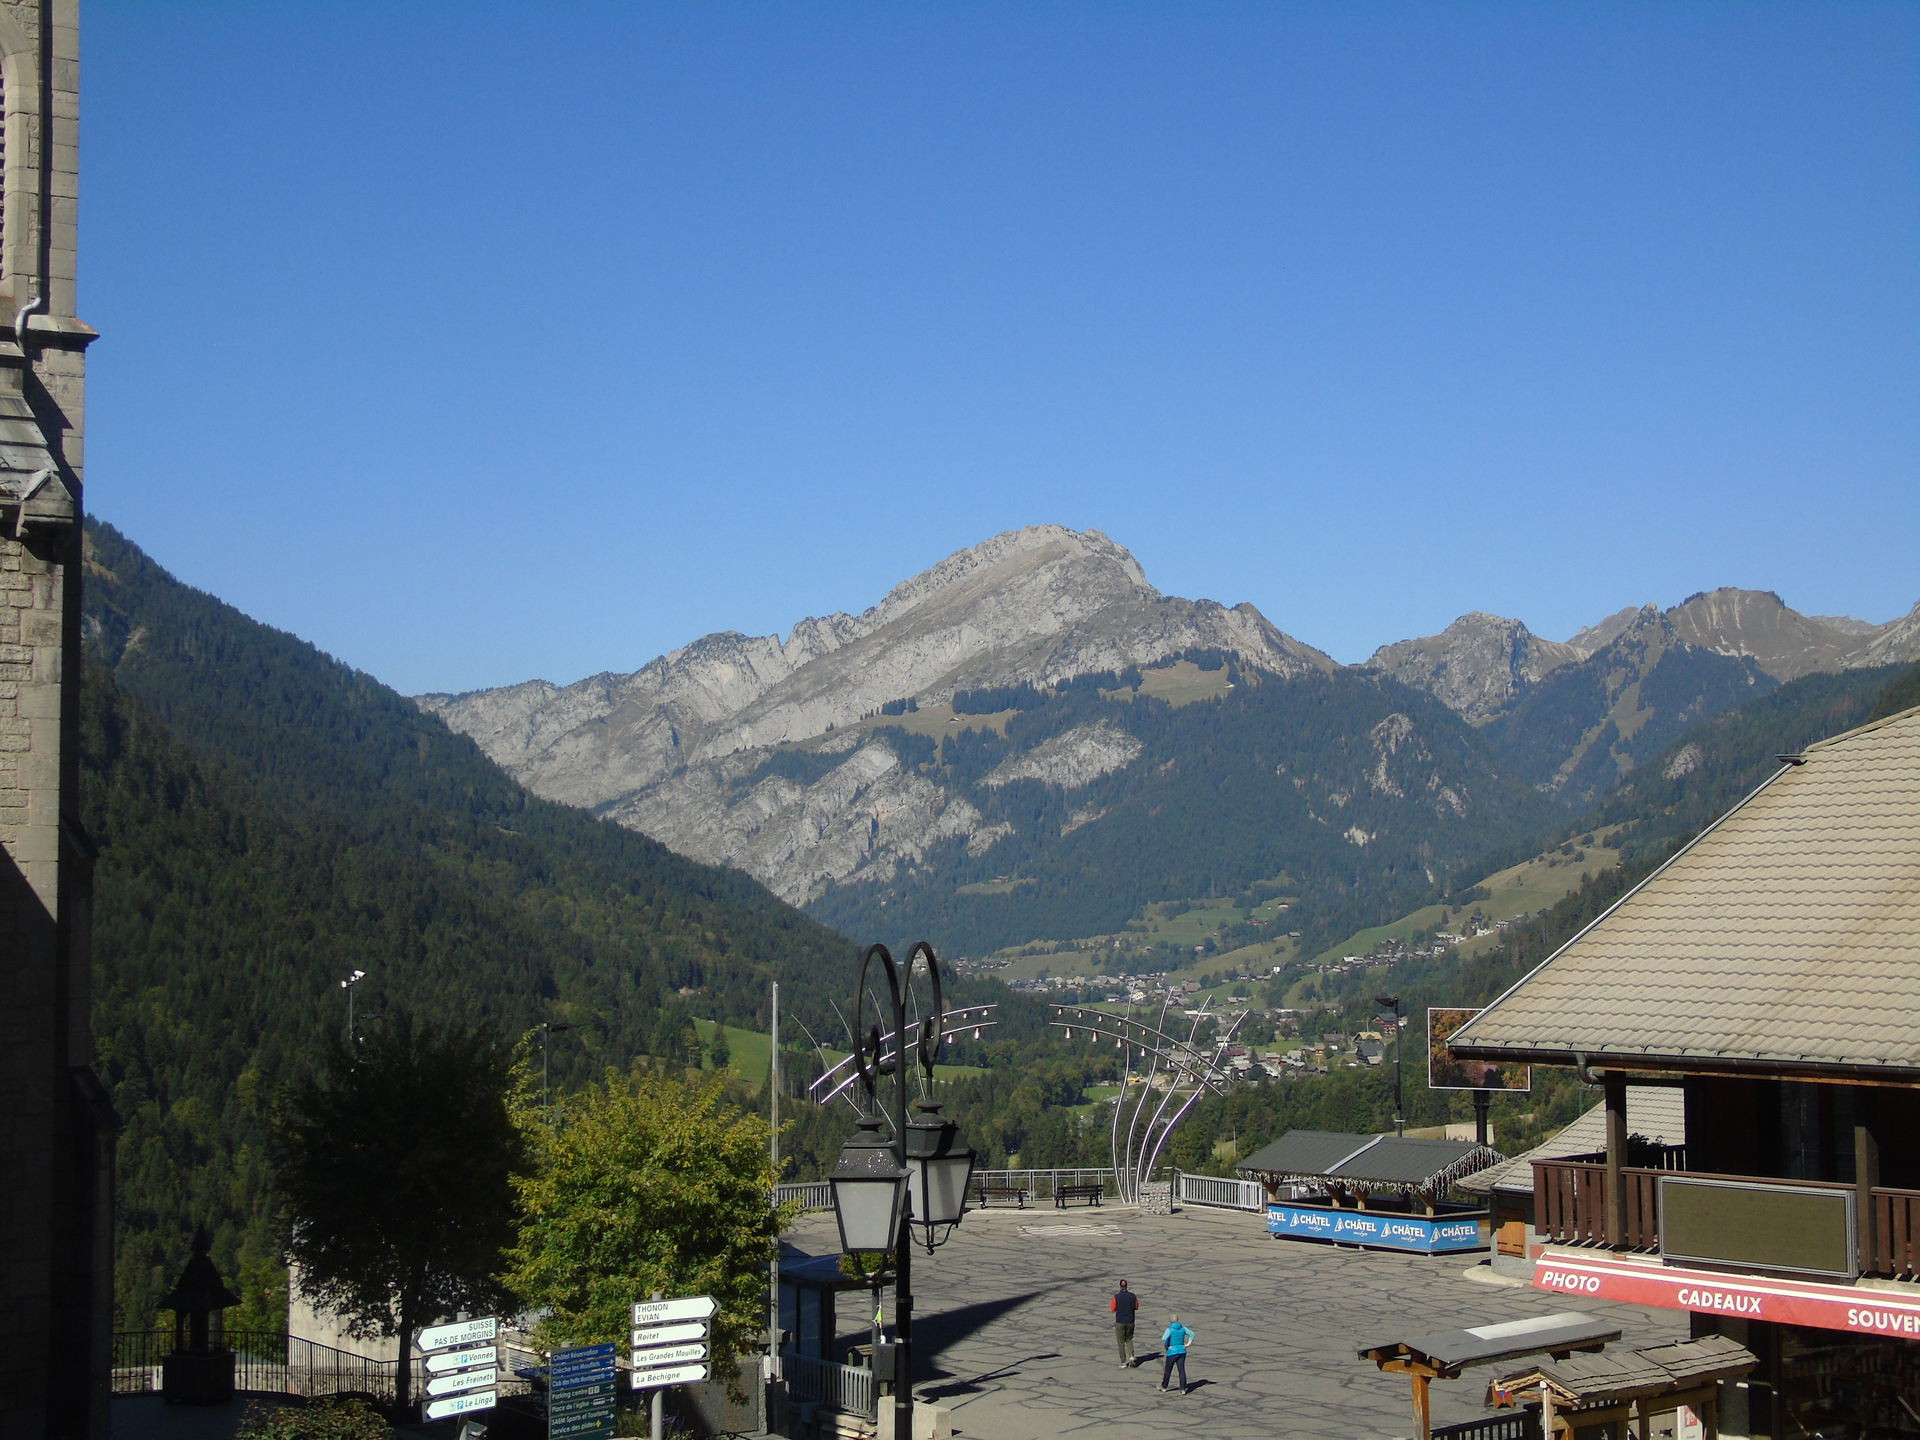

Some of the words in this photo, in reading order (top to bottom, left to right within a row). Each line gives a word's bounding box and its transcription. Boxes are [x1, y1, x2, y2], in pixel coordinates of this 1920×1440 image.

[1300, 1214, 1331, 1227] CHÂTEL
[1344, 1219, 1377, 1232] CHÂTEL
[1392, 1224, 1425, 1238] CHÂTEL
[1441, 1225, 1476, 1238] CHÂTEL
[1541, 1271, 1600, 1293] PHOTO
[1677, 1288, 1762, 1314] CADEAUX
[637, 1303, 669, 1313] THONON
[637, 1313, 660, 1322] EVIAN
[469, 1320, 493, 1331] SUISSE
[434, 1337, 448, 1347] PAS
[450, 1335, 459, 1344] DE
[461, 1329, 494, 1342] MORGINS
[637, 1332, 660, 1341] Roitet
[469, 1351, 494, 1361] Vonnes
[637, 1354, 648, 1362] Les
[649, 1352, 674, 1361] Grandes
[676, 1348, 701, 1358] Mouilles
[453, 1379, 464, 1387] Les
[466, 1373, 493, 1384] Freinets
[636, 1375, 645, 1383] La
[465, 1399, 474, 1407] Le
[475, 1396, 493, 1406] Linga
